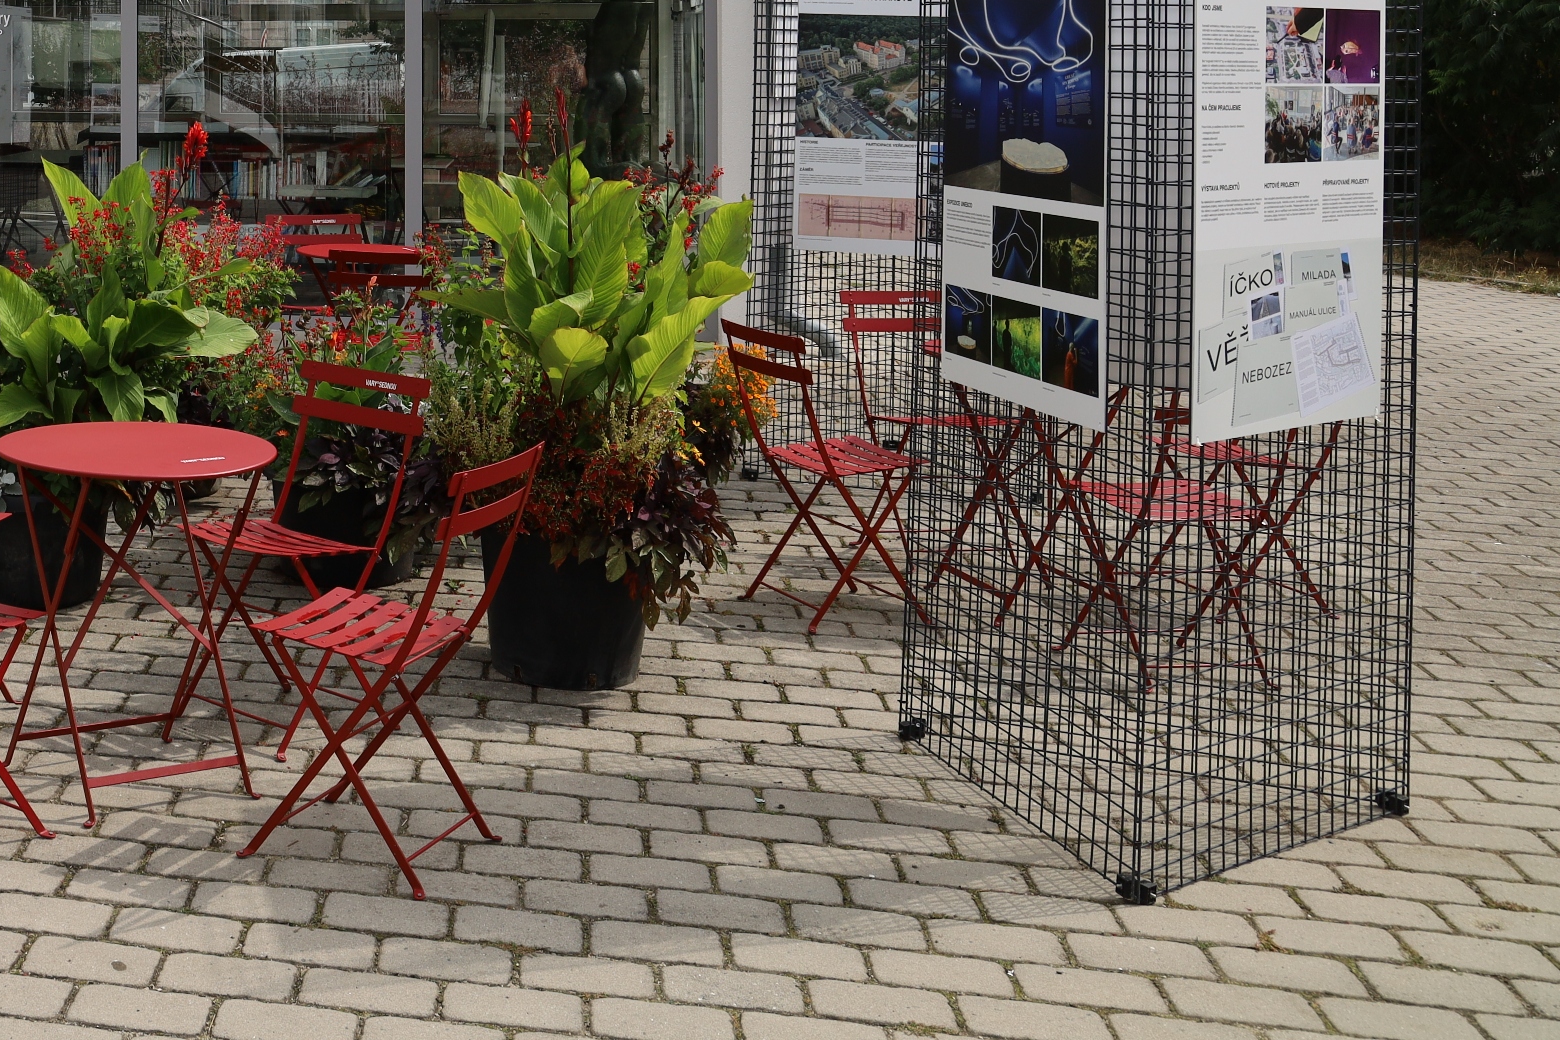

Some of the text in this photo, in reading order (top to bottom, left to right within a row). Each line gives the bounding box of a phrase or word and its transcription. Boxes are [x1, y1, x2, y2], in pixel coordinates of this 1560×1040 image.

[1229, 269, 1273, 297] ÍČKO
[1301, 269, 1337, 281] MILADA
[1290, 306, 1337, 320] MANUÁL ULICE
[1241, 362, 1292, 384] NEBOZEZ
